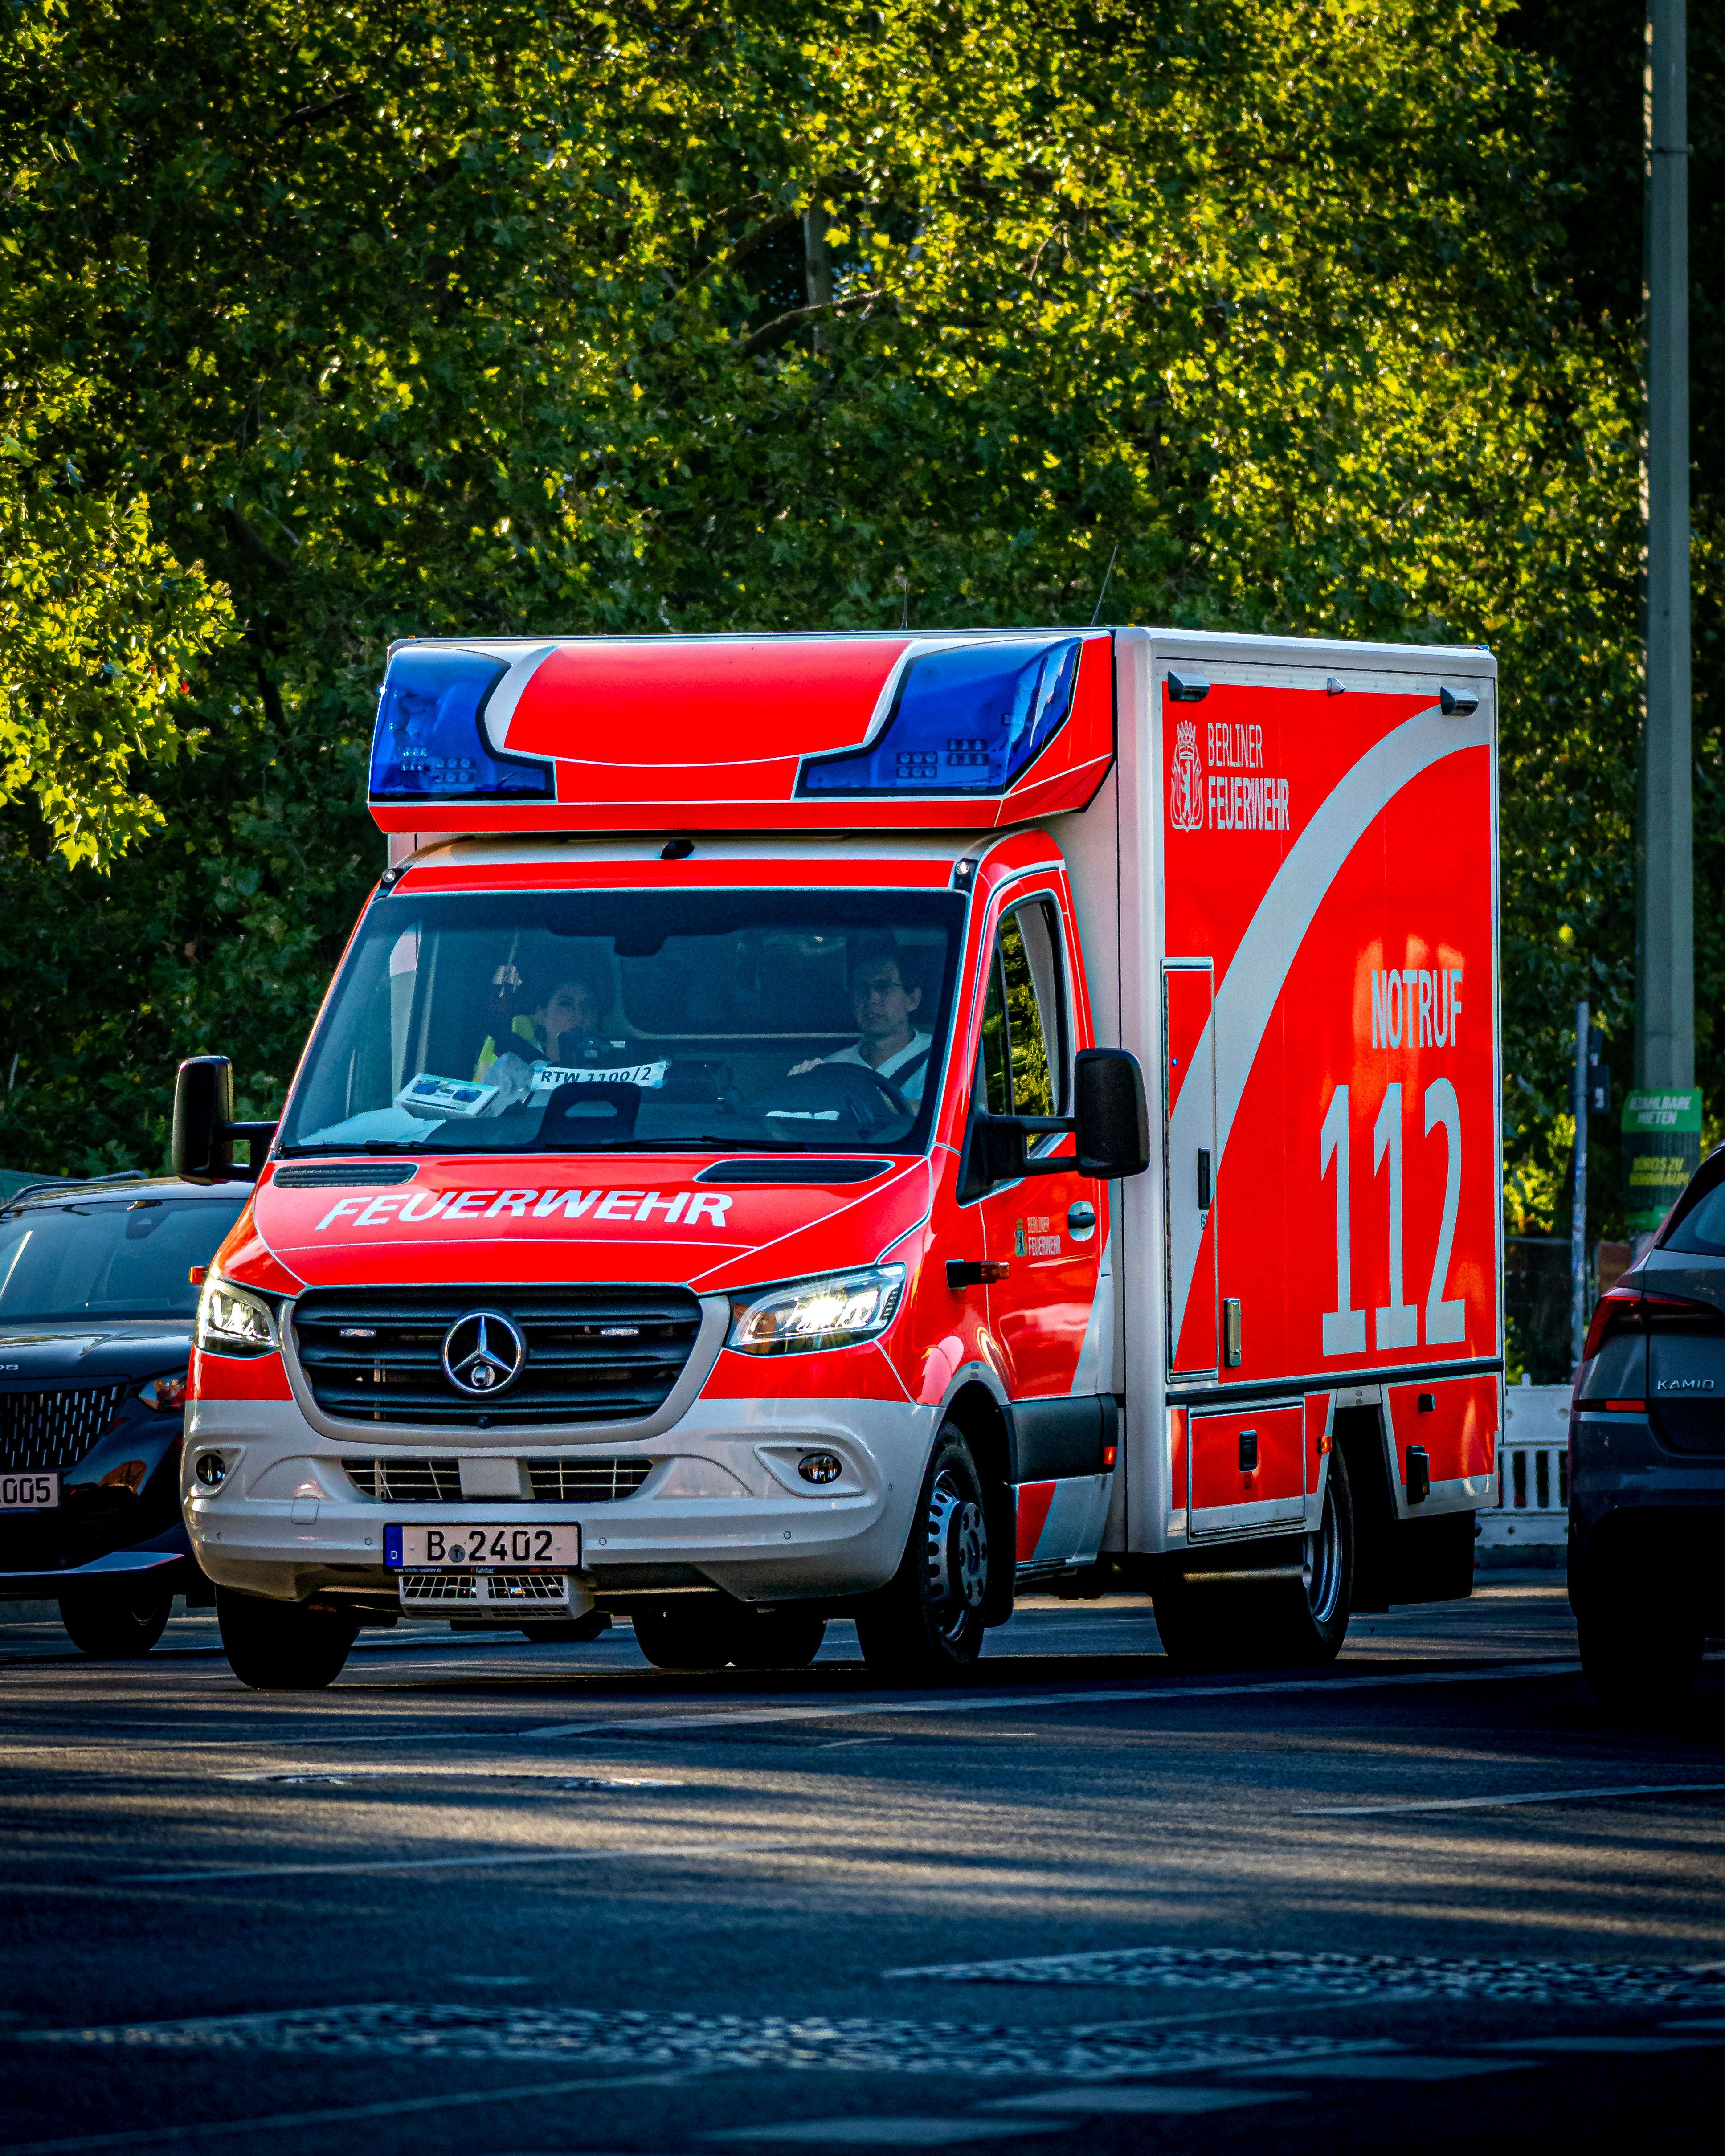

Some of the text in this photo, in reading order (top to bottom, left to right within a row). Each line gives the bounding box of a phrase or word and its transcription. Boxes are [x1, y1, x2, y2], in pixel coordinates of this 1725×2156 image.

[1208, 723, 1263, 768] BERLINER
[1208, 776, 1290, 830] FEUERWEHR
[1372, 970, 1462, 1049] NOTRUF
[541, 1067, 652, 1082] RTW 1100/2
[315, 1190, 733, 1230] FEUERWEHR
[1321, 1077, 1465, 1356] 112
[1028, 1235, 1061, 1256] FEUERWEHR
[1657, 1380, 1715, 1390] KAMIQ
[0, 1477, 51, 1504] 005
[391, 1551, 397, 1559] D
[427, 1530, 553, 1561] B 2402
